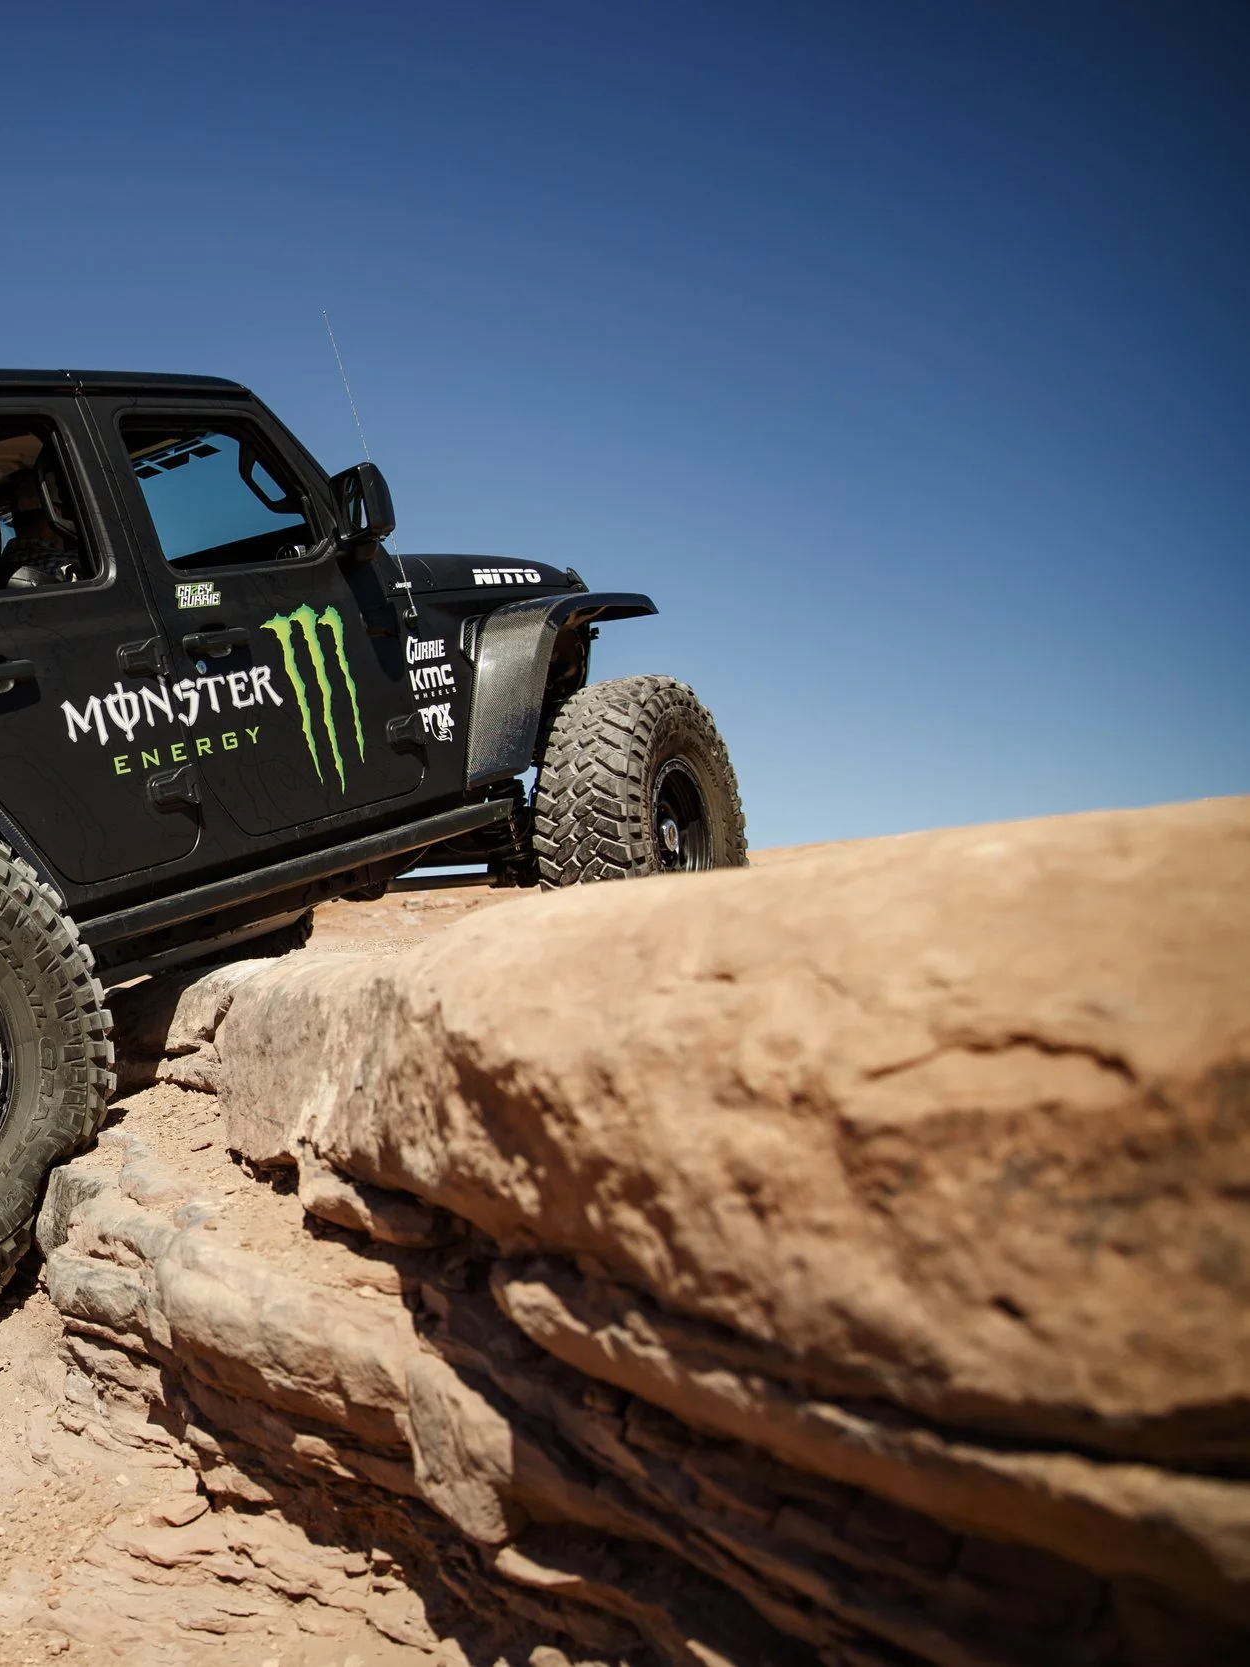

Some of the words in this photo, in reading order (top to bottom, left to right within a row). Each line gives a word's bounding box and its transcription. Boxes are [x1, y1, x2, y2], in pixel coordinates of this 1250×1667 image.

[471, 568, 542, 585] NITTO
[180, 593, 220, 607] CURRIE
[406, 635, 446, 665] CURRIE
[409, 664, 455, 692] KMC
[60, 664, 284, 746] MONSTER
[414, 686, 457, 700] WHEELS
[417, 702, 455, 738] FOX
[113, 726, 261, 775] ENERGY
